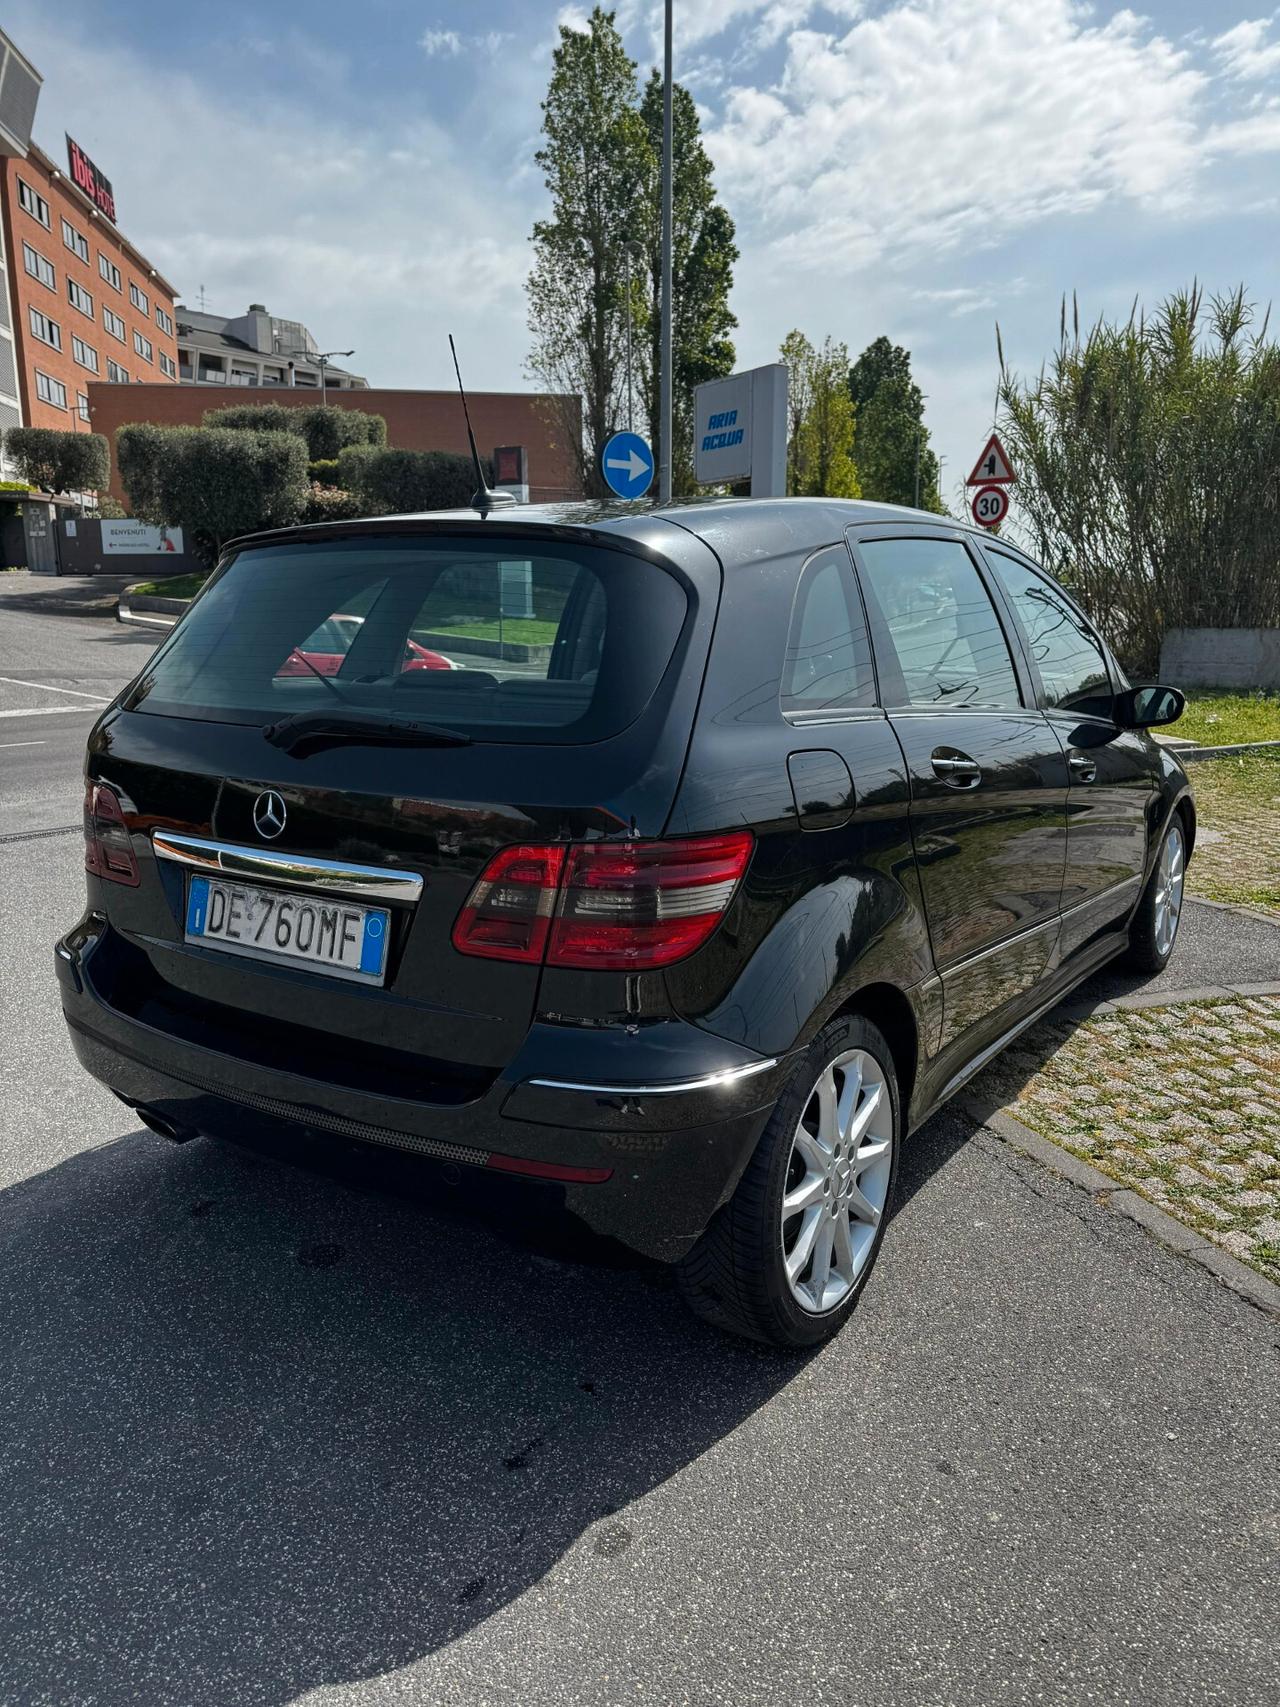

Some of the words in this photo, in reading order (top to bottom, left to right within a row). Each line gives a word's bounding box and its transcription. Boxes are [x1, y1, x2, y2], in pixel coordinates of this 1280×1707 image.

[71, 142, 95, 198] ibis
[96, 182, 116, 219] HOTE
[708, 409, 738, 431] ARIA
[702, 428, 744, 451] ACQUA
[979, 497, 1000, 516] 30
[110, 528, 146, 536] BENVENUTI
